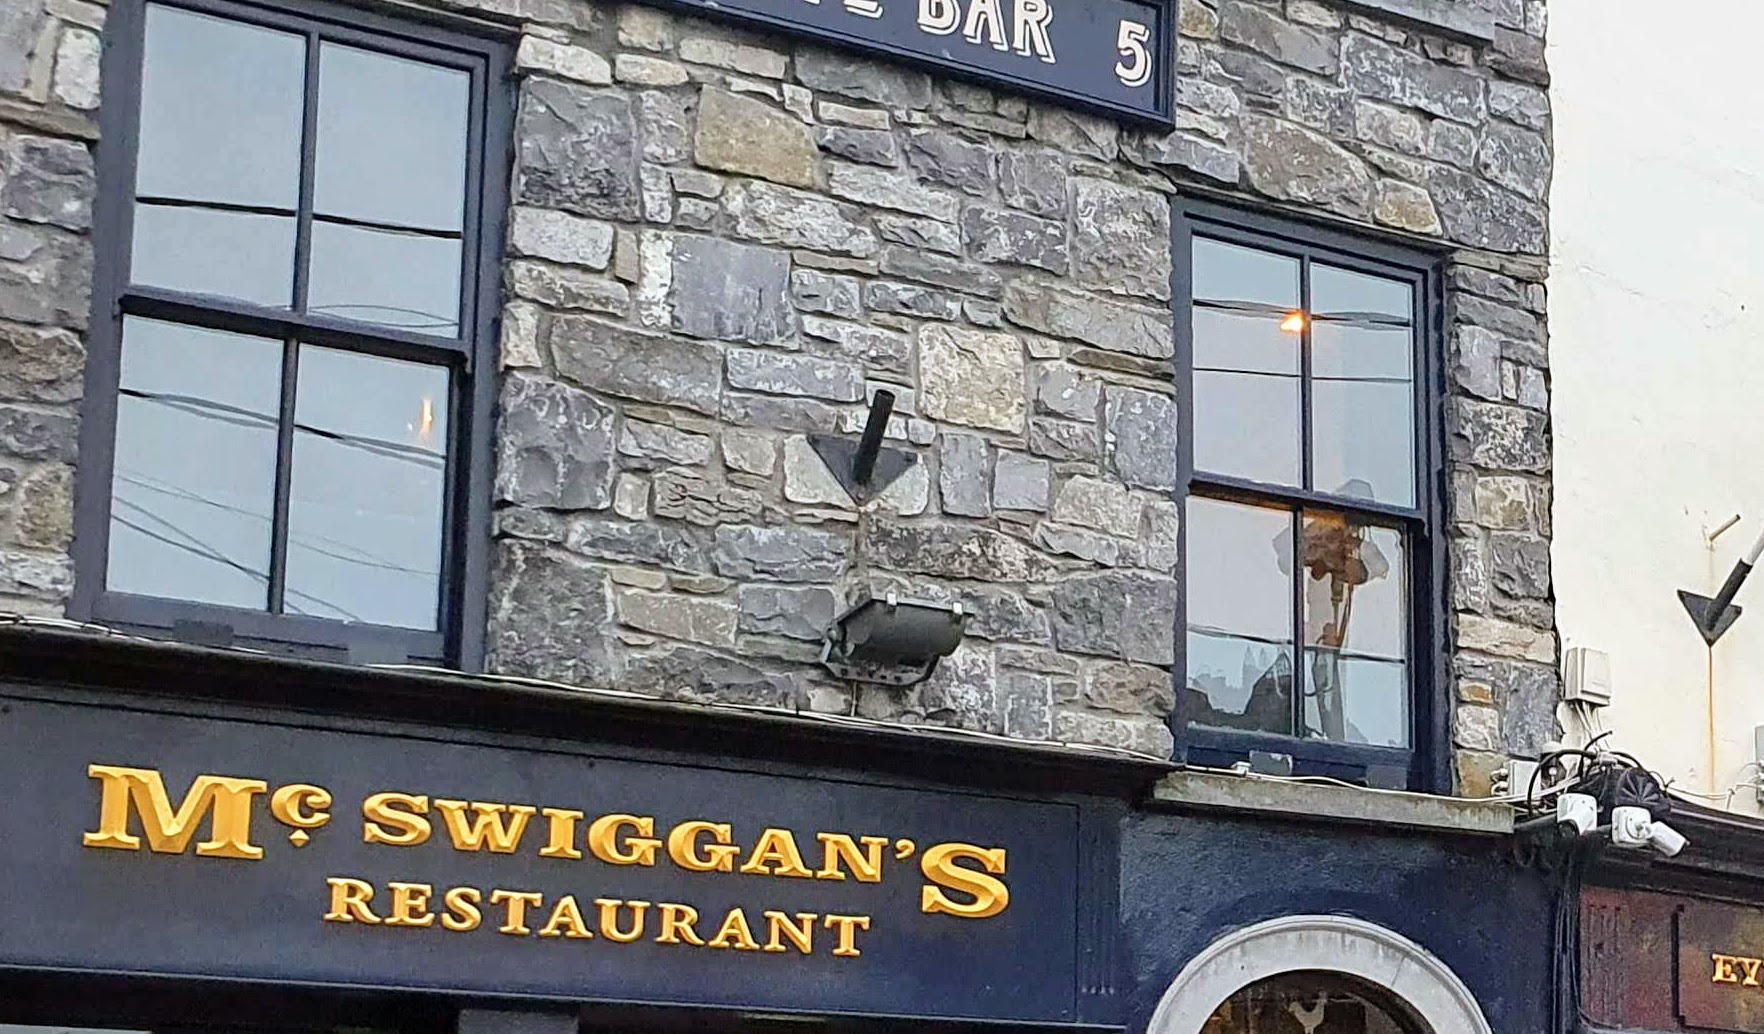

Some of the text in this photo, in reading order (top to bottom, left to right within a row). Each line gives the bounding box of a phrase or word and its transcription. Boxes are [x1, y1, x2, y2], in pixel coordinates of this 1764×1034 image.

[1116, 20, 1151, 86] 5
[362, 792, 1009, 918] SWIGGAN'S
[324, 877, 872, 957] RESTAURANT
